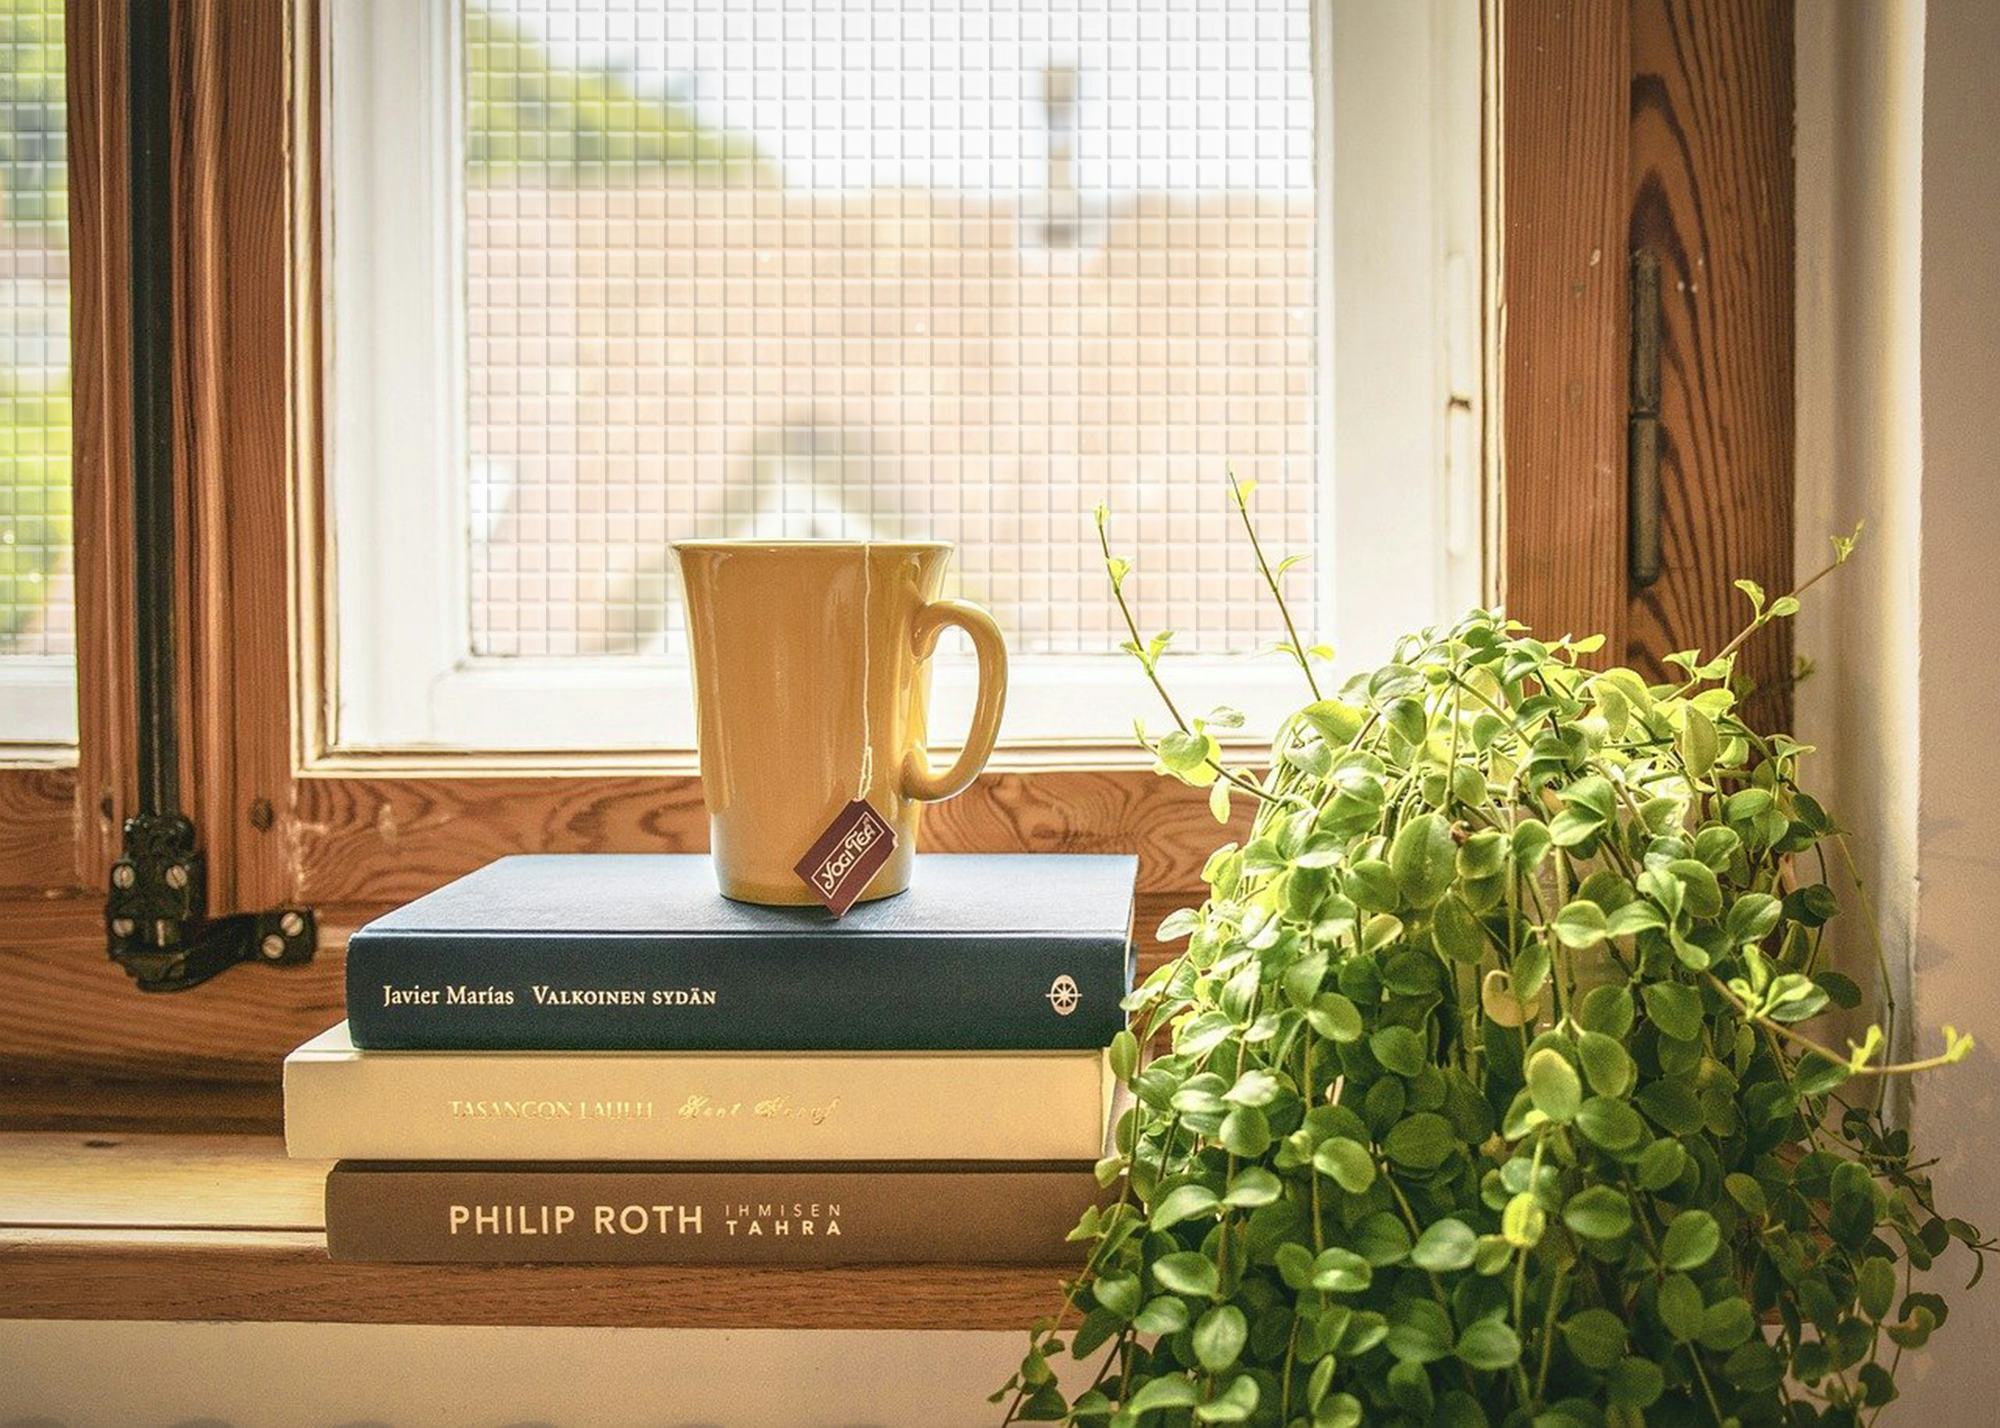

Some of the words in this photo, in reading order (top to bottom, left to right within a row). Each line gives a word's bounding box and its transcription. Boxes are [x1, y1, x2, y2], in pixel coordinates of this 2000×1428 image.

[383, 985, 440, 1007] Javier
[446, 985, 514, 1006] Marías
[449, 1204, 575, 1235] PHILIP
[594, 1204, 703, 1235] ROTH
[725, 1203, 841, 1218] IHMISEN
[725, 1219, 842, 1236] TAHRA
